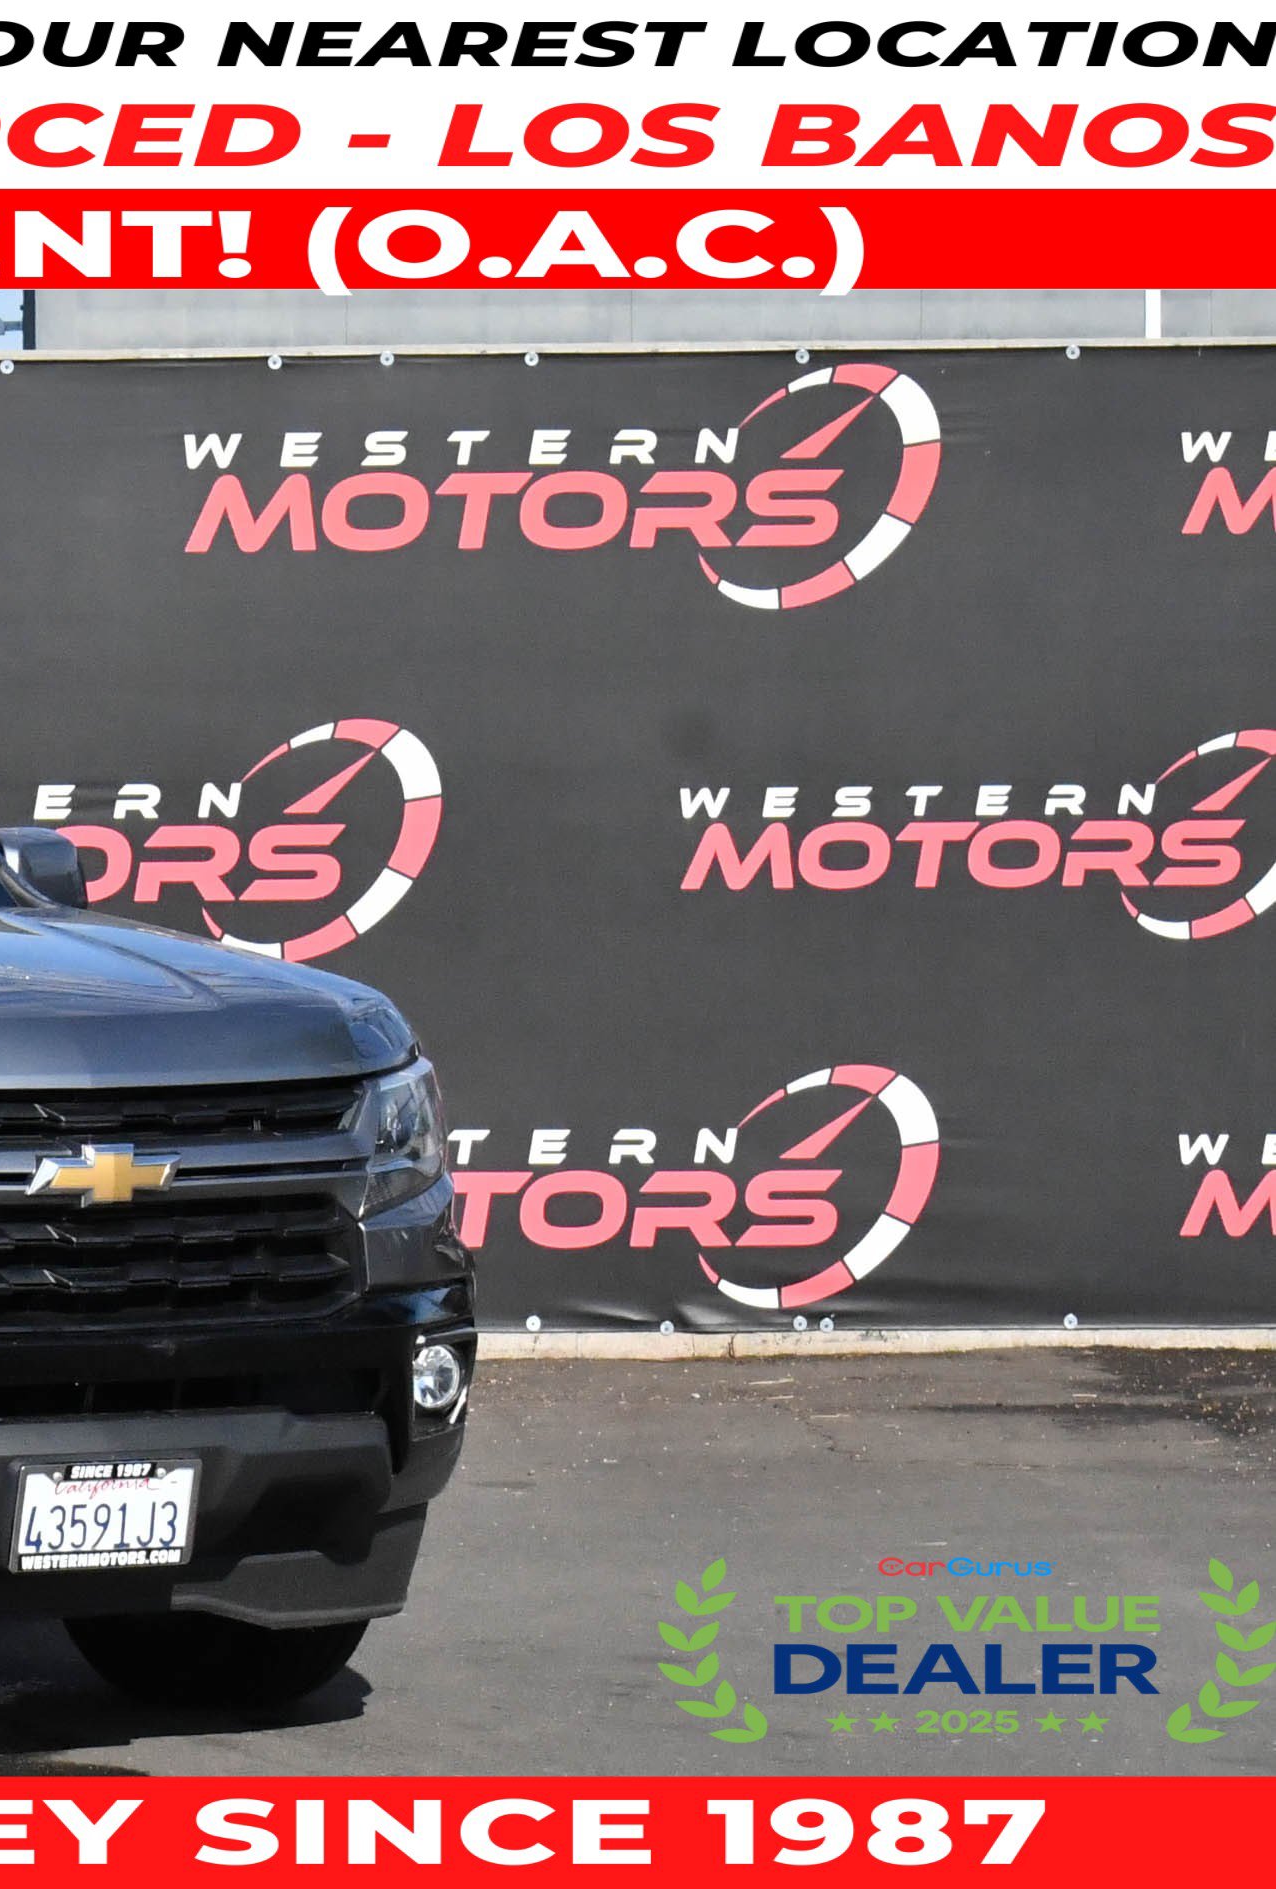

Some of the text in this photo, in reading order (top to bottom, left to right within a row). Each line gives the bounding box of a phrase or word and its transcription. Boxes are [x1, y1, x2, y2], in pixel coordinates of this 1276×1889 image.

[184, 428, 739, 468] WESTERN
[185, 468, 844, 553] MOTORS
[680, 784, 1156, 818] WESTERN
[681, 819, 1245, 891] MOTORS
[447, 1128, 738, 1165] TERN
[451, 1169, 843, 1250] TORS
[70, 1462, 152, 1480] SINCE 1987
[24, 1501, 179, 1552] 43591J3
[20, 1548, 182, 1571] WESTERNMOTORS.COM
